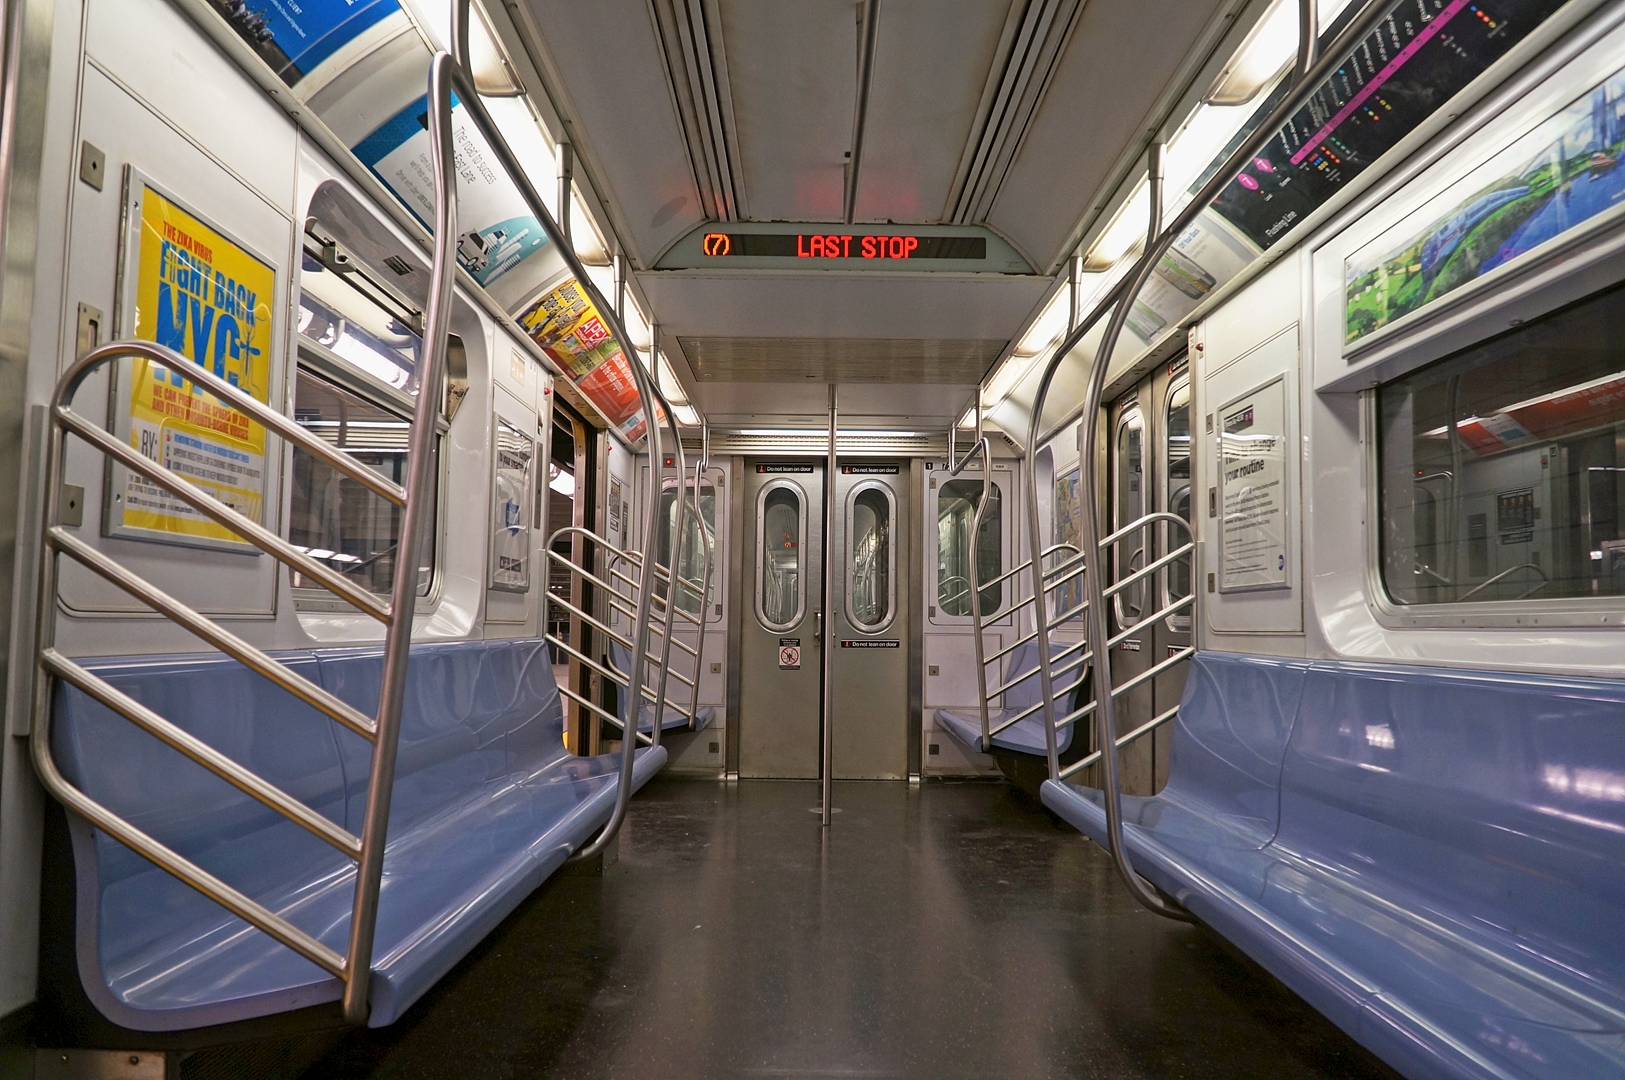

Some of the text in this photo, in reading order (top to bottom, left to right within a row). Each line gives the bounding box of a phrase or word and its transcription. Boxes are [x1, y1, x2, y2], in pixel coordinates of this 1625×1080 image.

[452, 125, 498, 185] The road to success
[459, 165, 477, 184] Lane
[1265, 208, 1298, 237] Flushing Line
[163, 220, 212, 264] THE ZIKA VIRUS
[796, 234, 918, 258] LAST STOP
[160, 238, 256, 327] FIGHT BACK
[558, 280, 587, 312] Choose your
[582, 317, 612, 347] APEX
[152, 398, 164, 412] AND
[166, 401, 184, 418] OTHER
[230, 424, 249, 440] VIRUSES
[153, 383, 250, 428] WE CAN PREVENT THE SPREAD OF ZIKA
[141, 430, 158, 462] BY:
[1225, 460, 1264, 486] your routine
